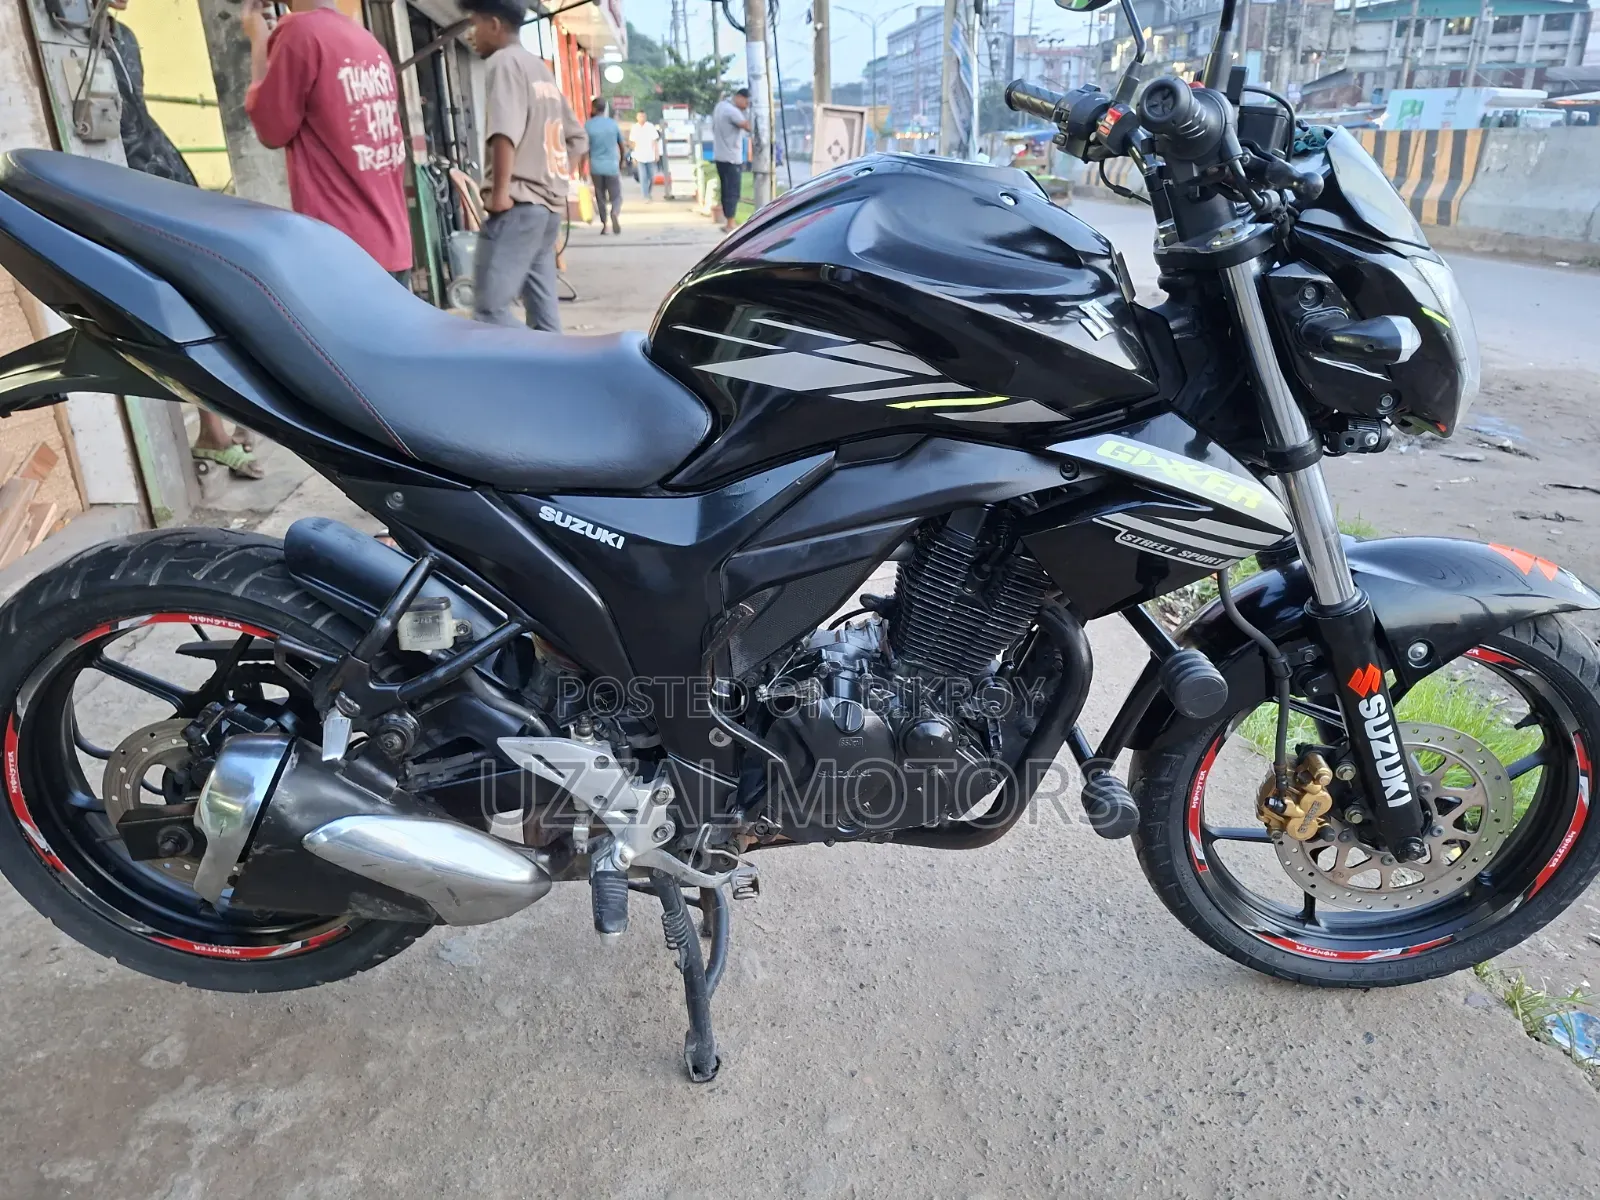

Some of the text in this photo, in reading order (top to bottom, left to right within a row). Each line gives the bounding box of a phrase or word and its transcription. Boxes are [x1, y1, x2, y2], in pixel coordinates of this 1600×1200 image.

[1097, 440, 1263, 509] GIXXER
[539, 505, 625, 550] SUZUKI
[1123, 533, 1225, 566] STREET SPORT
[188, 614, 242, 629] MONSTER
[1358, 694, 1412, 807] SUZUKI
